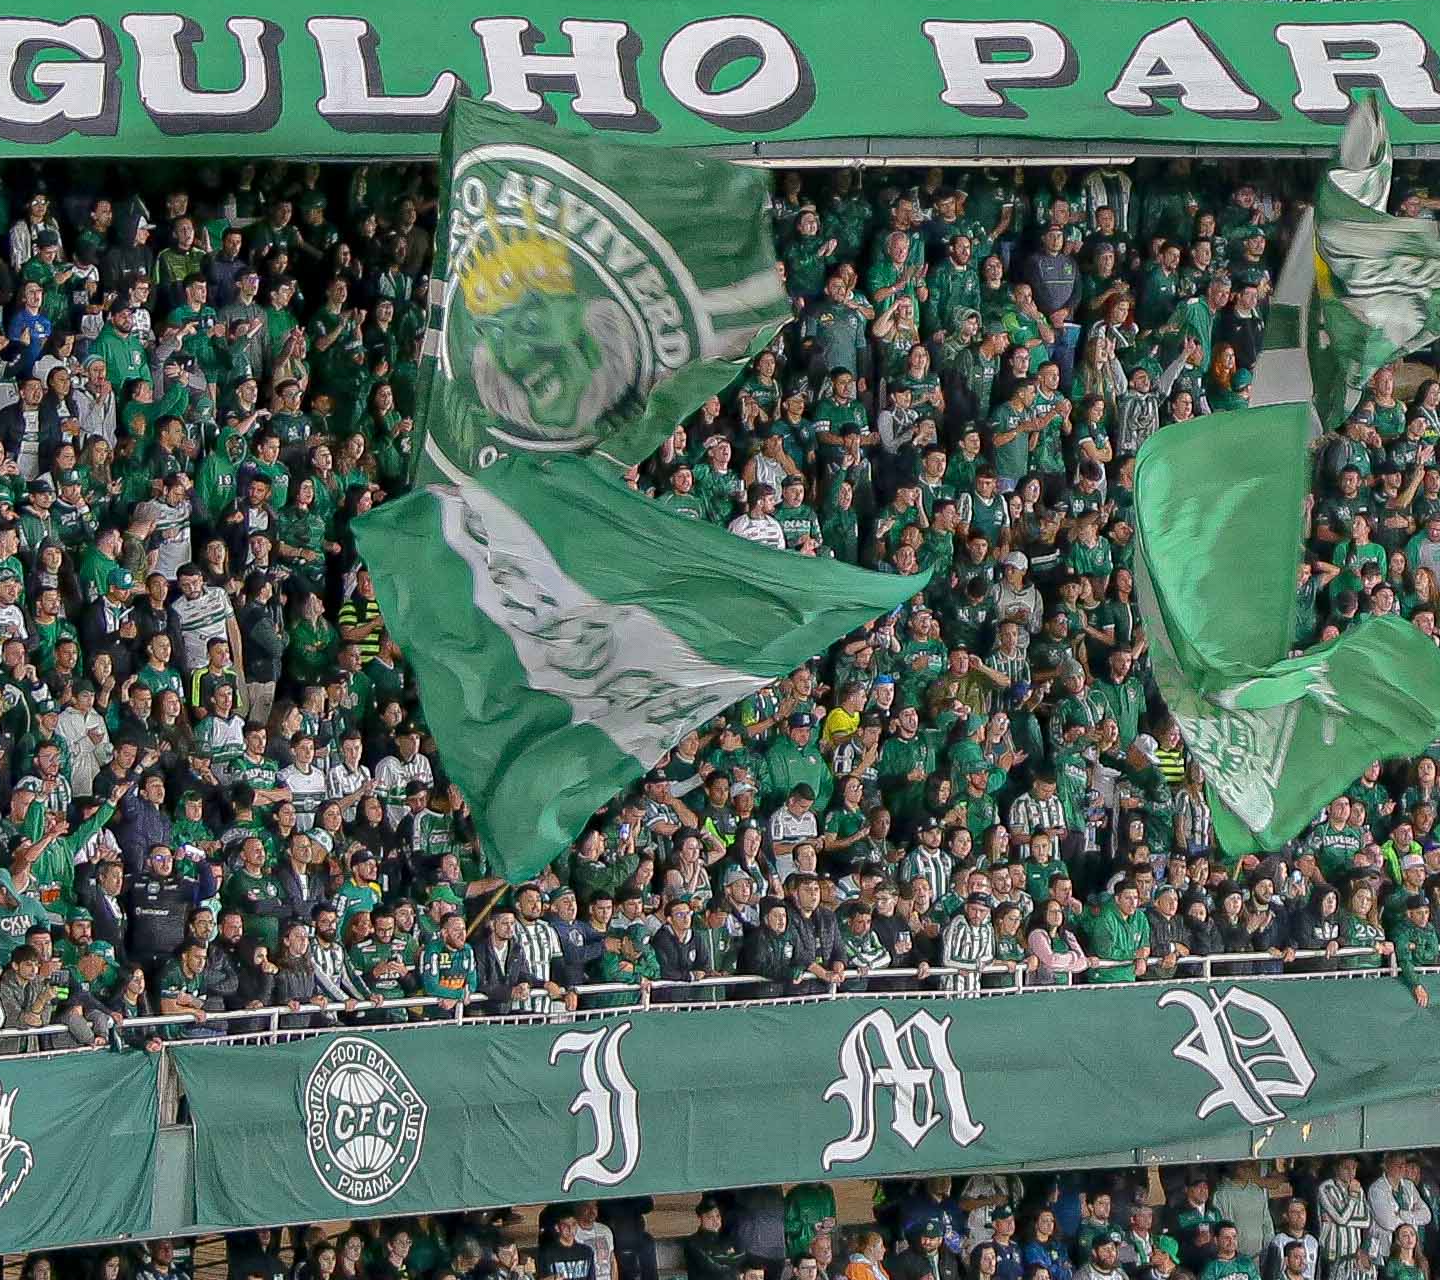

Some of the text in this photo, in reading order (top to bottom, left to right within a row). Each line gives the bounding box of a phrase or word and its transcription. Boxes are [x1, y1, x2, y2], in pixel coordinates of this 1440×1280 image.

[310, 1044, 420, 1151] CORITIBA FOOT BALL CLUB
[334, 1101, 398, 1141] CFC
[337, 1167, 394, 1198] PARANÁ
